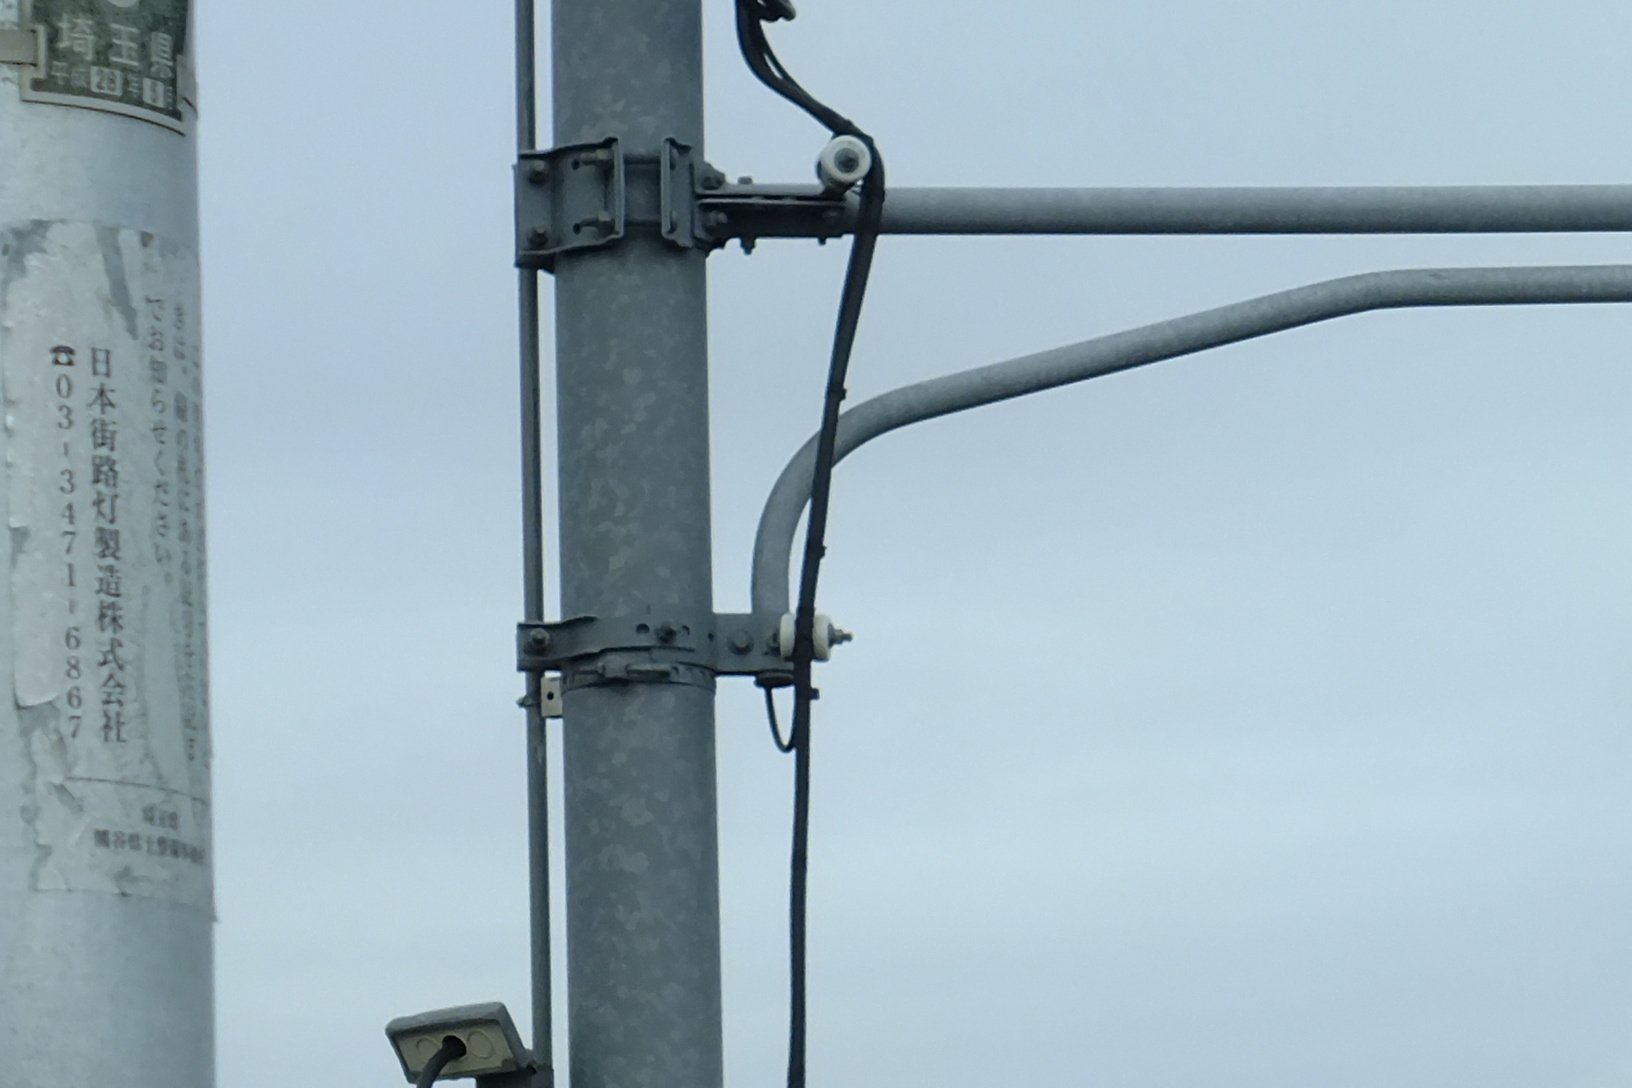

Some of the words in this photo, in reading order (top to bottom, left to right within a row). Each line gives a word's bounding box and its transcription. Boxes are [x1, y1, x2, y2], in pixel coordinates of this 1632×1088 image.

[56, 14, 174, 79] 埼玉県
[87, 346, 127, 744] 日本街路灯製造株式会社
